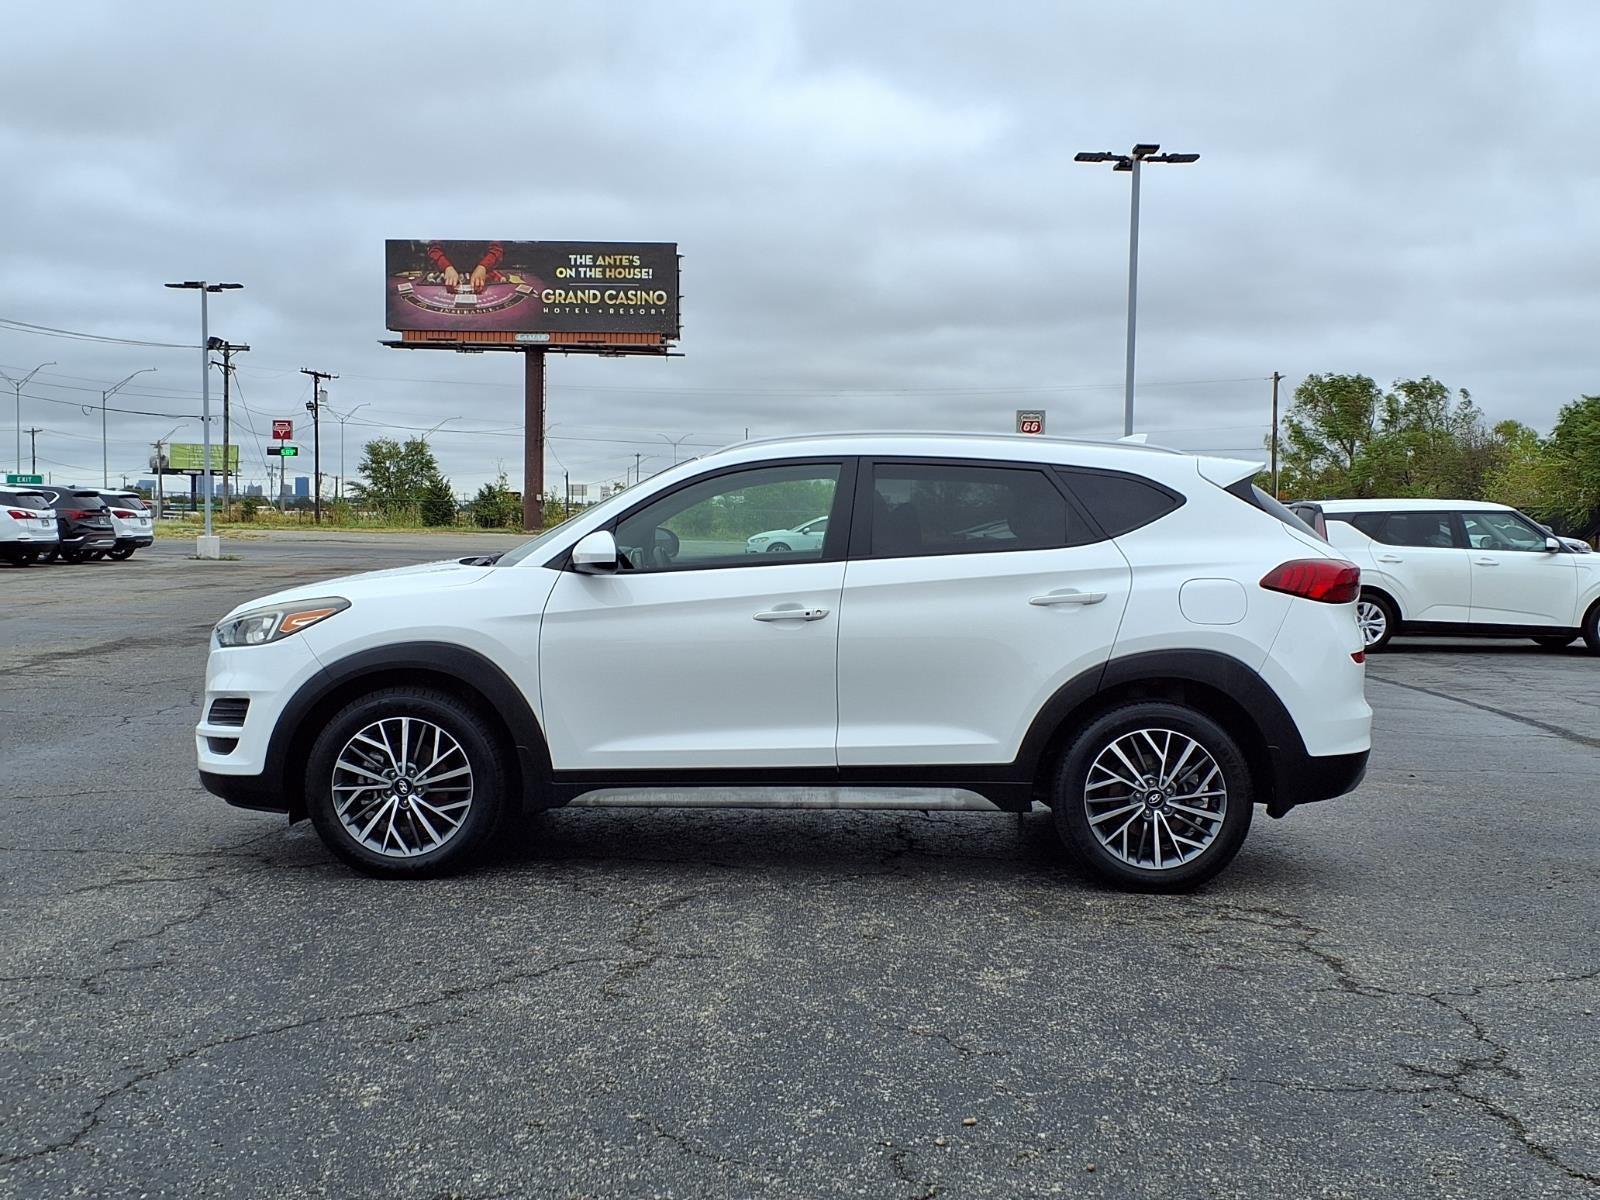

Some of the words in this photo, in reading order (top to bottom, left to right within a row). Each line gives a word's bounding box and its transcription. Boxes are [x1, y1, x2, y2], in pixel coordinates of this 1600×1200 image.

[568, 254, 593, 265] THE
[596, 255, 640, 266] ANTE'S
[555, 267, 576, 279] ON
[578, 268, 603, 279] THE
[605, 268, 653, 280] HOUSE!
[541, 289, 601, 304] GRAND
[604, 290, 668, 306] CASINO
[1023, 422, 1038, 431] 66
